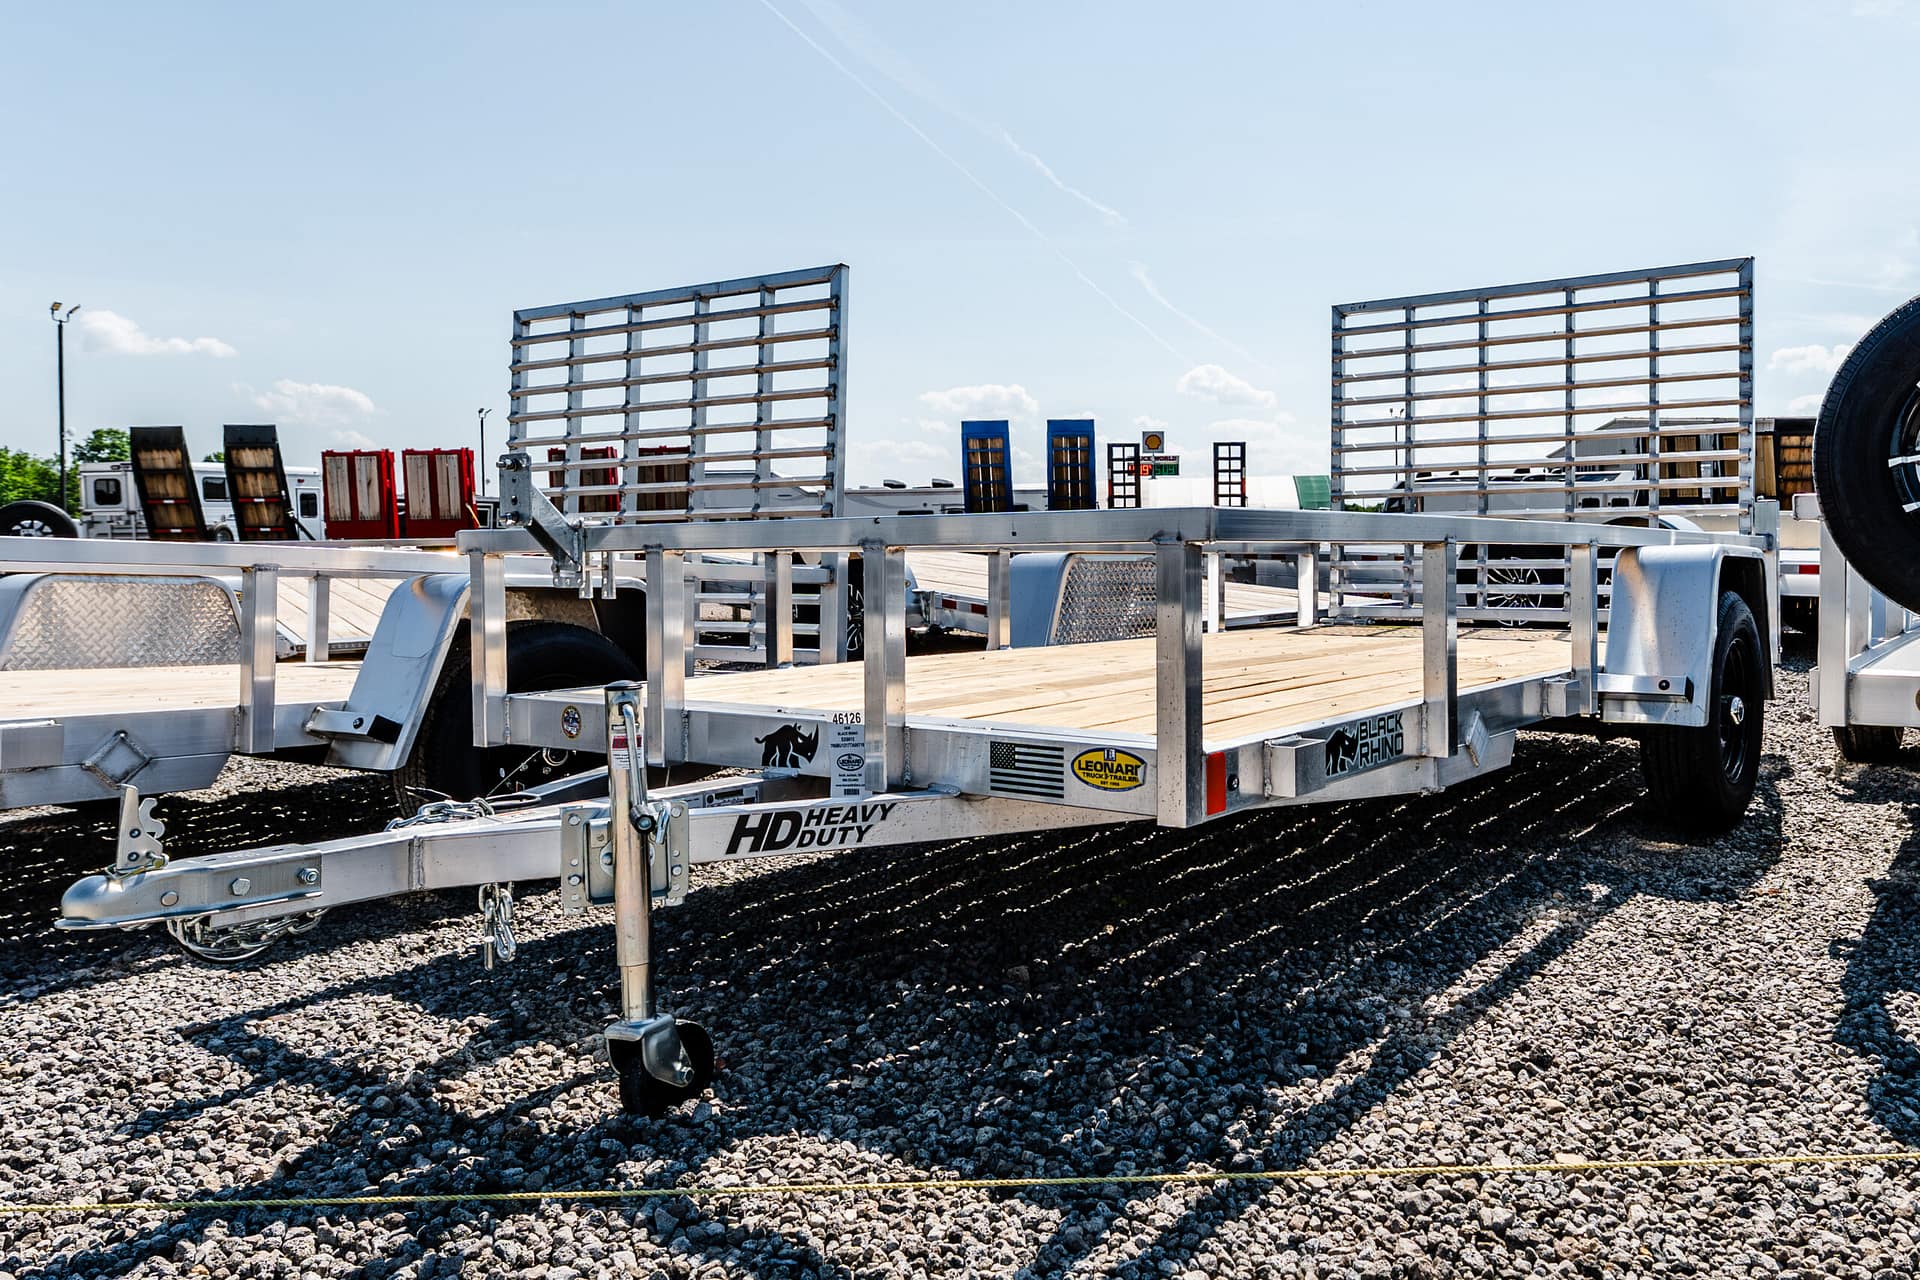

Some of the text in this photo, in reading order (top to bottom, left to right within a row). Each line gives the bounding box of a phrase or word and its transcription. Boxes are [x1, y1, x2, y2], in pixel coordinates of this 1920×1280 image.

[832, 712, 861, 725] 46126
[1359, 712, 1403, 740] BLACK
[1359, 732, 1404, 767] RHINO
[803, 803, 897, 828] HEAVY
[725, 811, 803, 855] HD
[796, 824, 874, 848] DUTY
